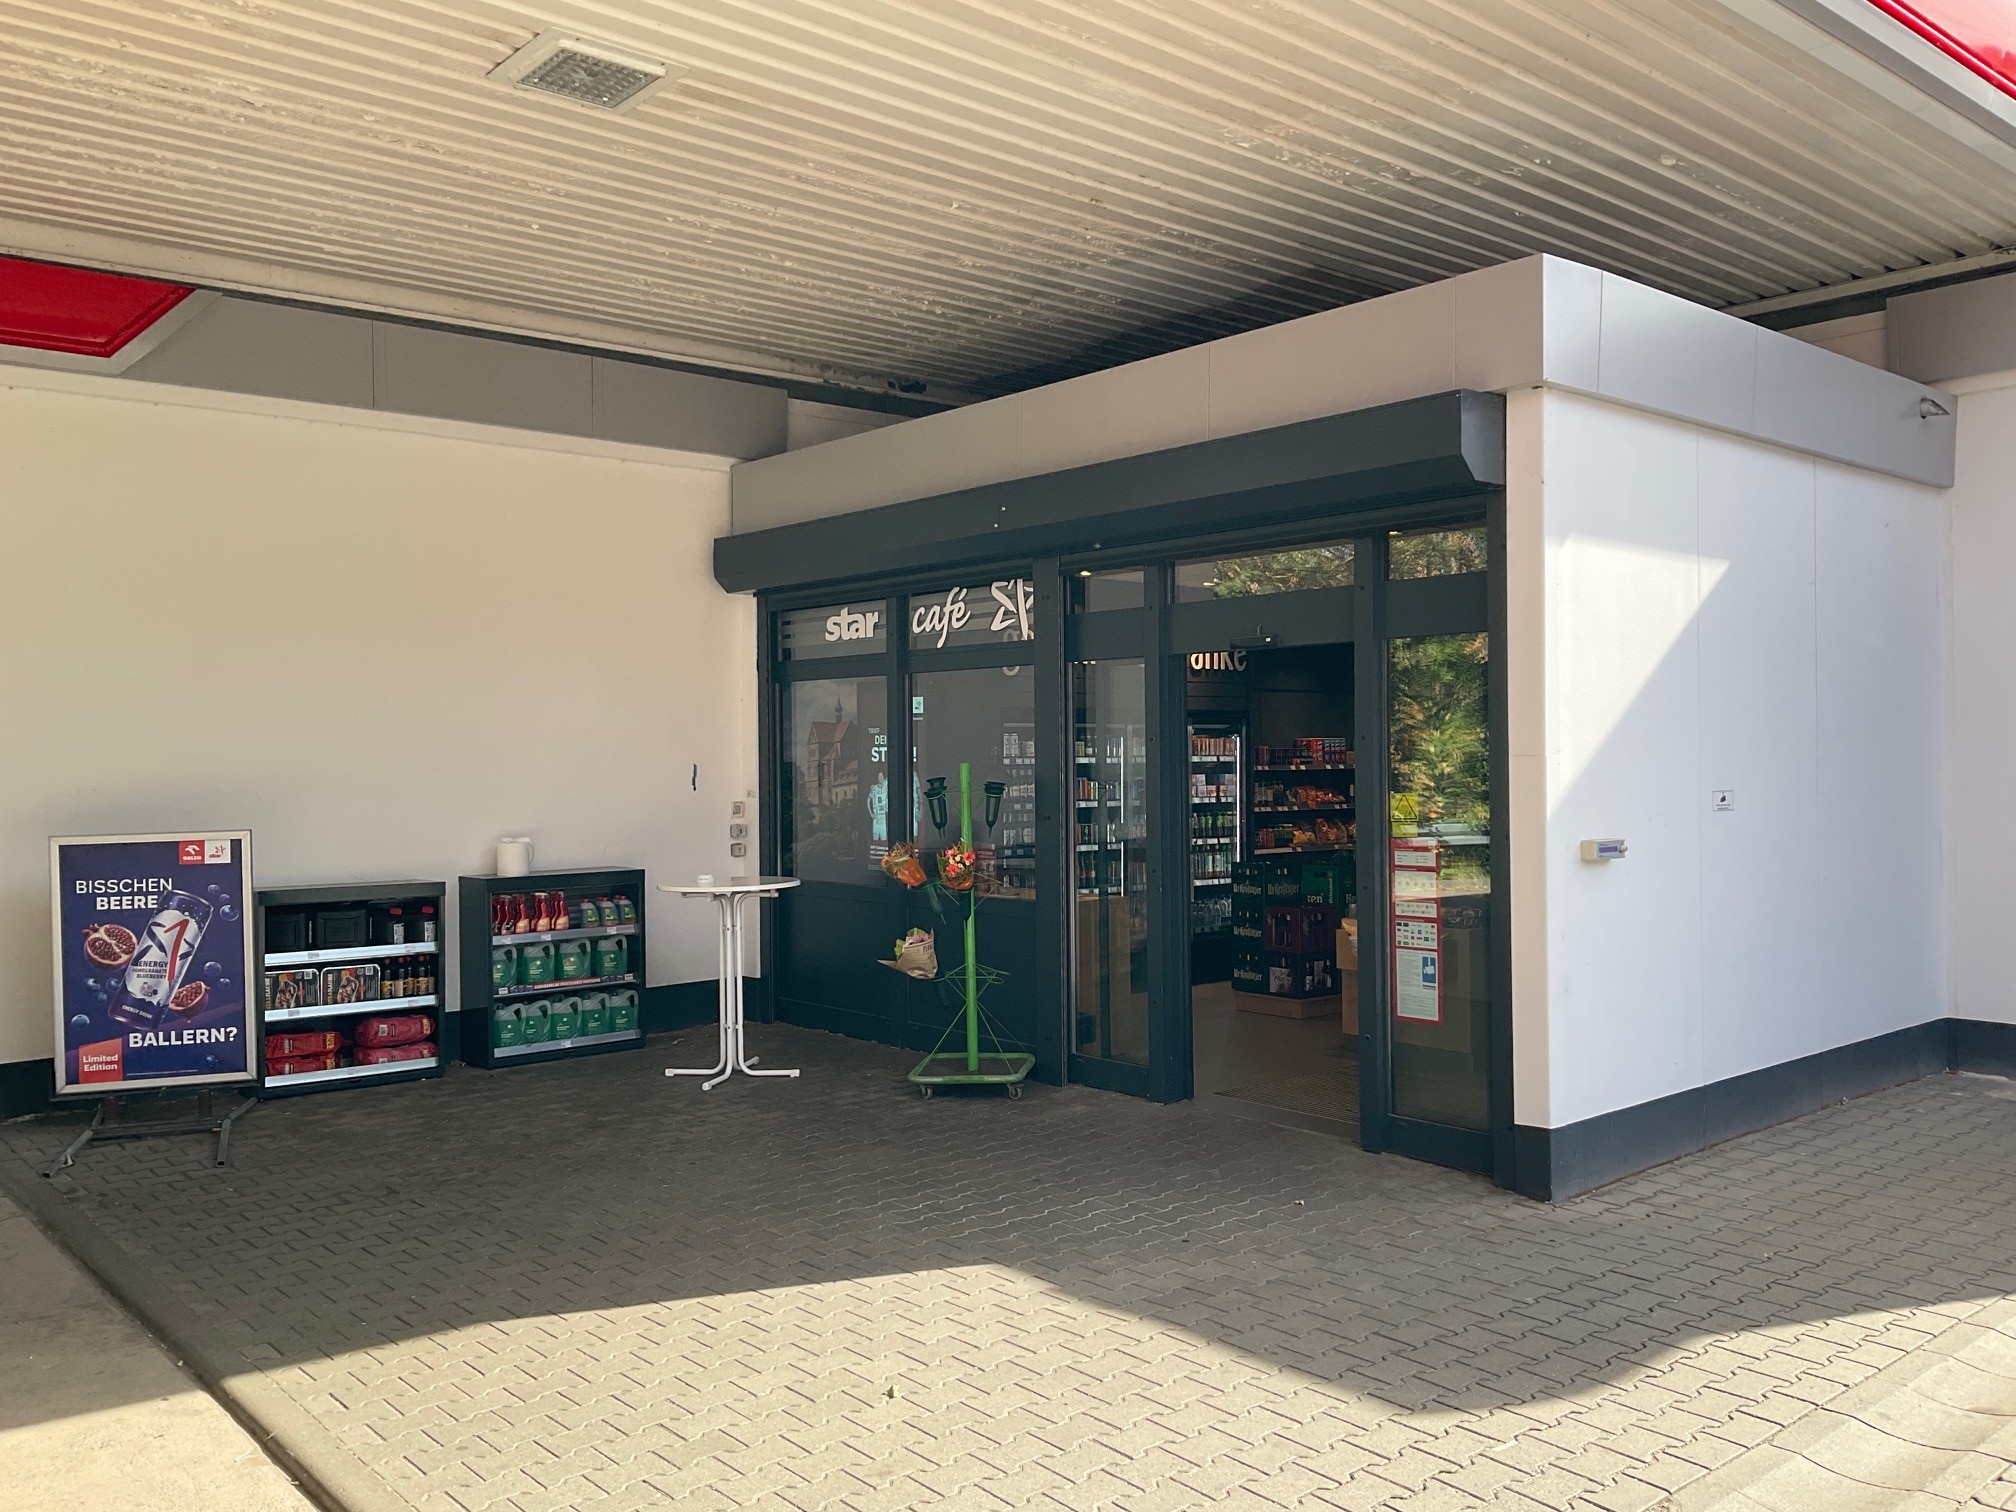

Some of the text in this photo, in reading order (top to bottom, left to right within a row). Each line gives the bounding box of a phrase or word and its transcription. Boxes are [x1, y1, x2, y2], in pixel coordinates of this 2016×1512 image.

[825, 586, 971, 649] star café
[75, 877, 172, 894] BISSCHEN
[96, 895, 159, 911] BEERE
[139, 960, 169, 968] ENERGY
[128, 1026, 238, 1048] BALLERN?
[82, 1053, 119, 1063] Limited
[83, 1063, 118, 1072] Edition
